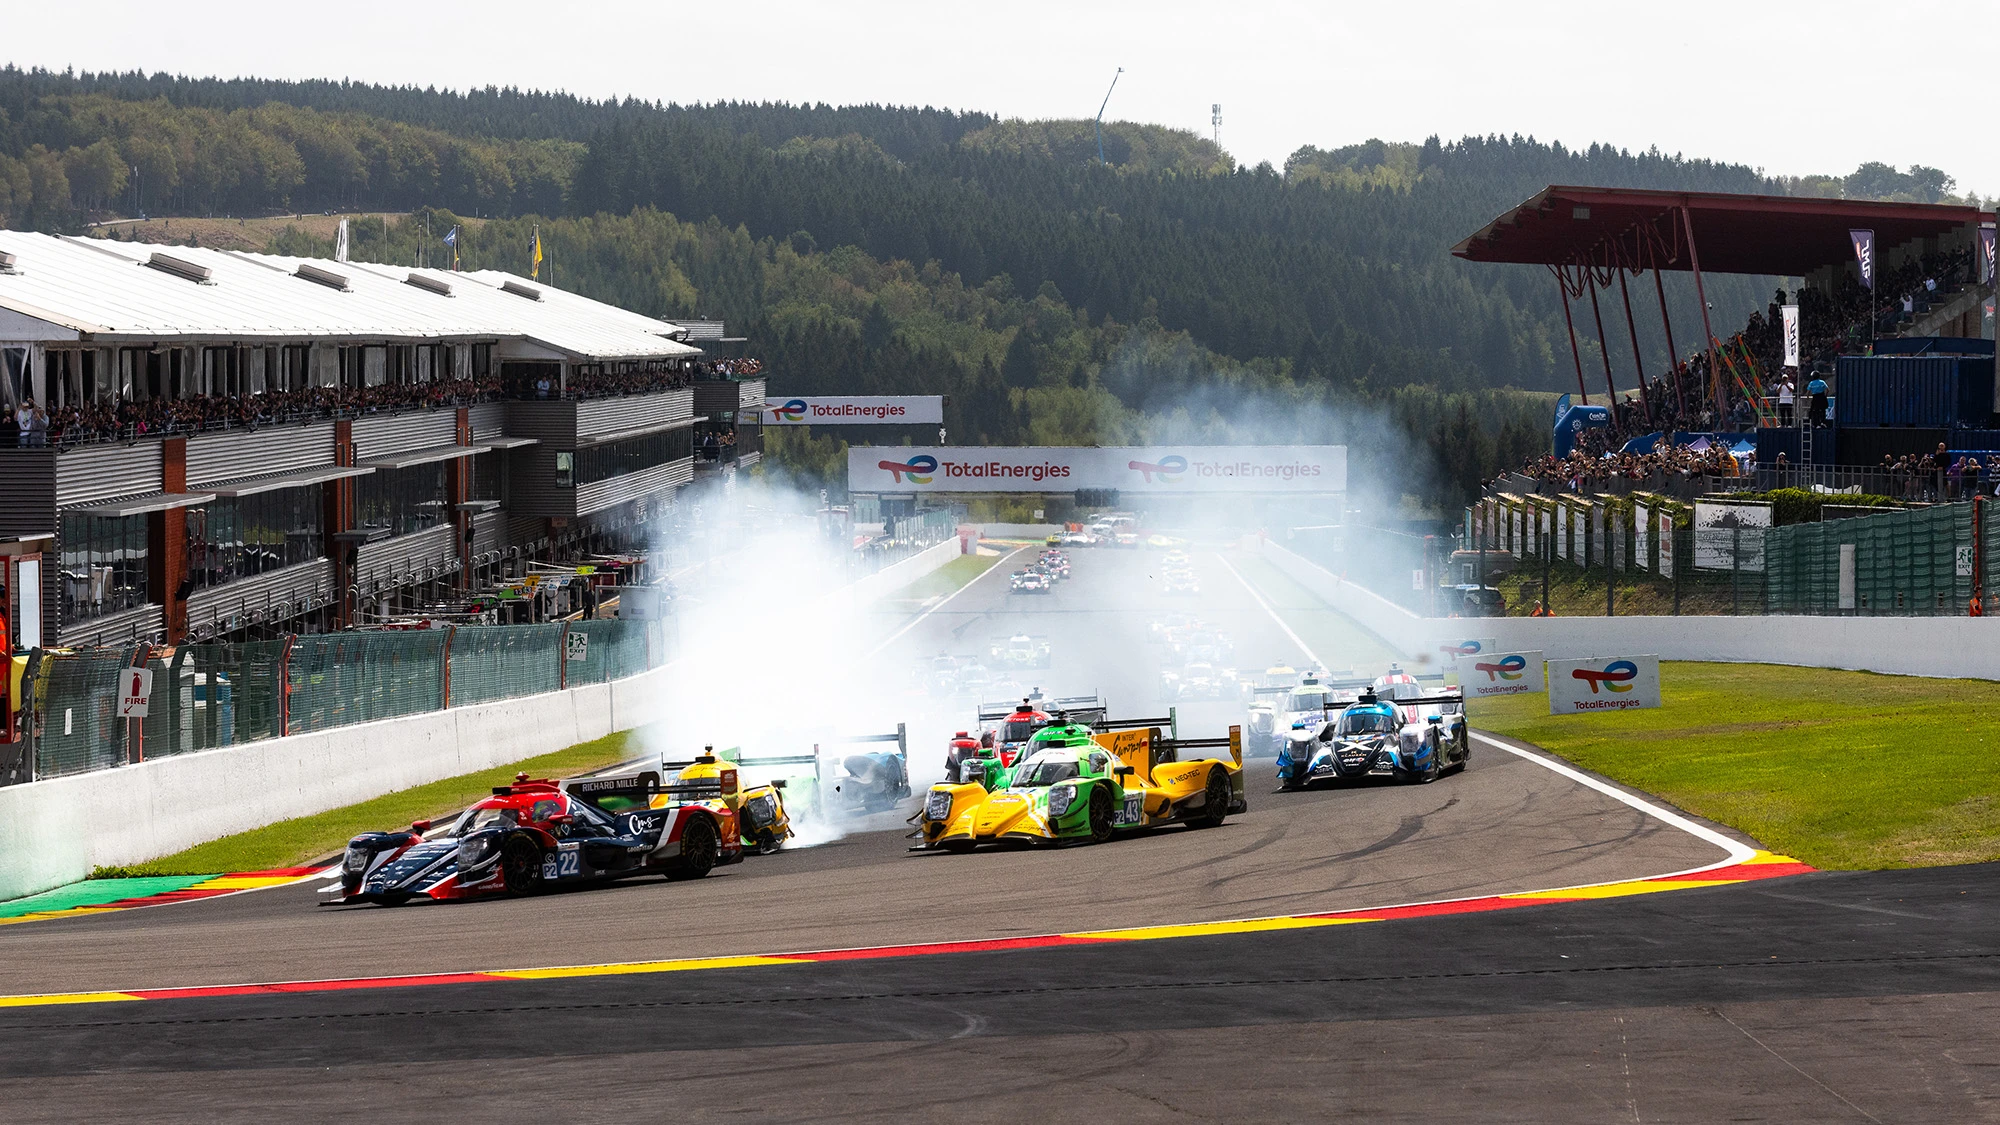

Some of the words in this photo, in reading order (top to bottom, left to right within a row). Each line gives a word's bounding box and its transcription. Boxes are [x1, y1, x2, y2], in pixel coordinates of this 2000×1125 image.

[810, 404, 905, 418] TotalEnergies
[942, 461, 1070, 481] TotalEnergies
[1192, 461, 1321, 481] TotalEnergies
[1476, 683, 1528, 694] TotalEnergies
[124, 697, 147, 705] FIRE
[1574, 698, 1640, 710] TotalEnergies
[582, 780, 615, 792] RICHARD
[616, 778, 638, 789] MILLE
[1114, 812, 1124, 823] P2
[1126, 801, 1139, 822] 43
[560, 851, 578, 875] 22
[544, 865, 556, 877] P2
